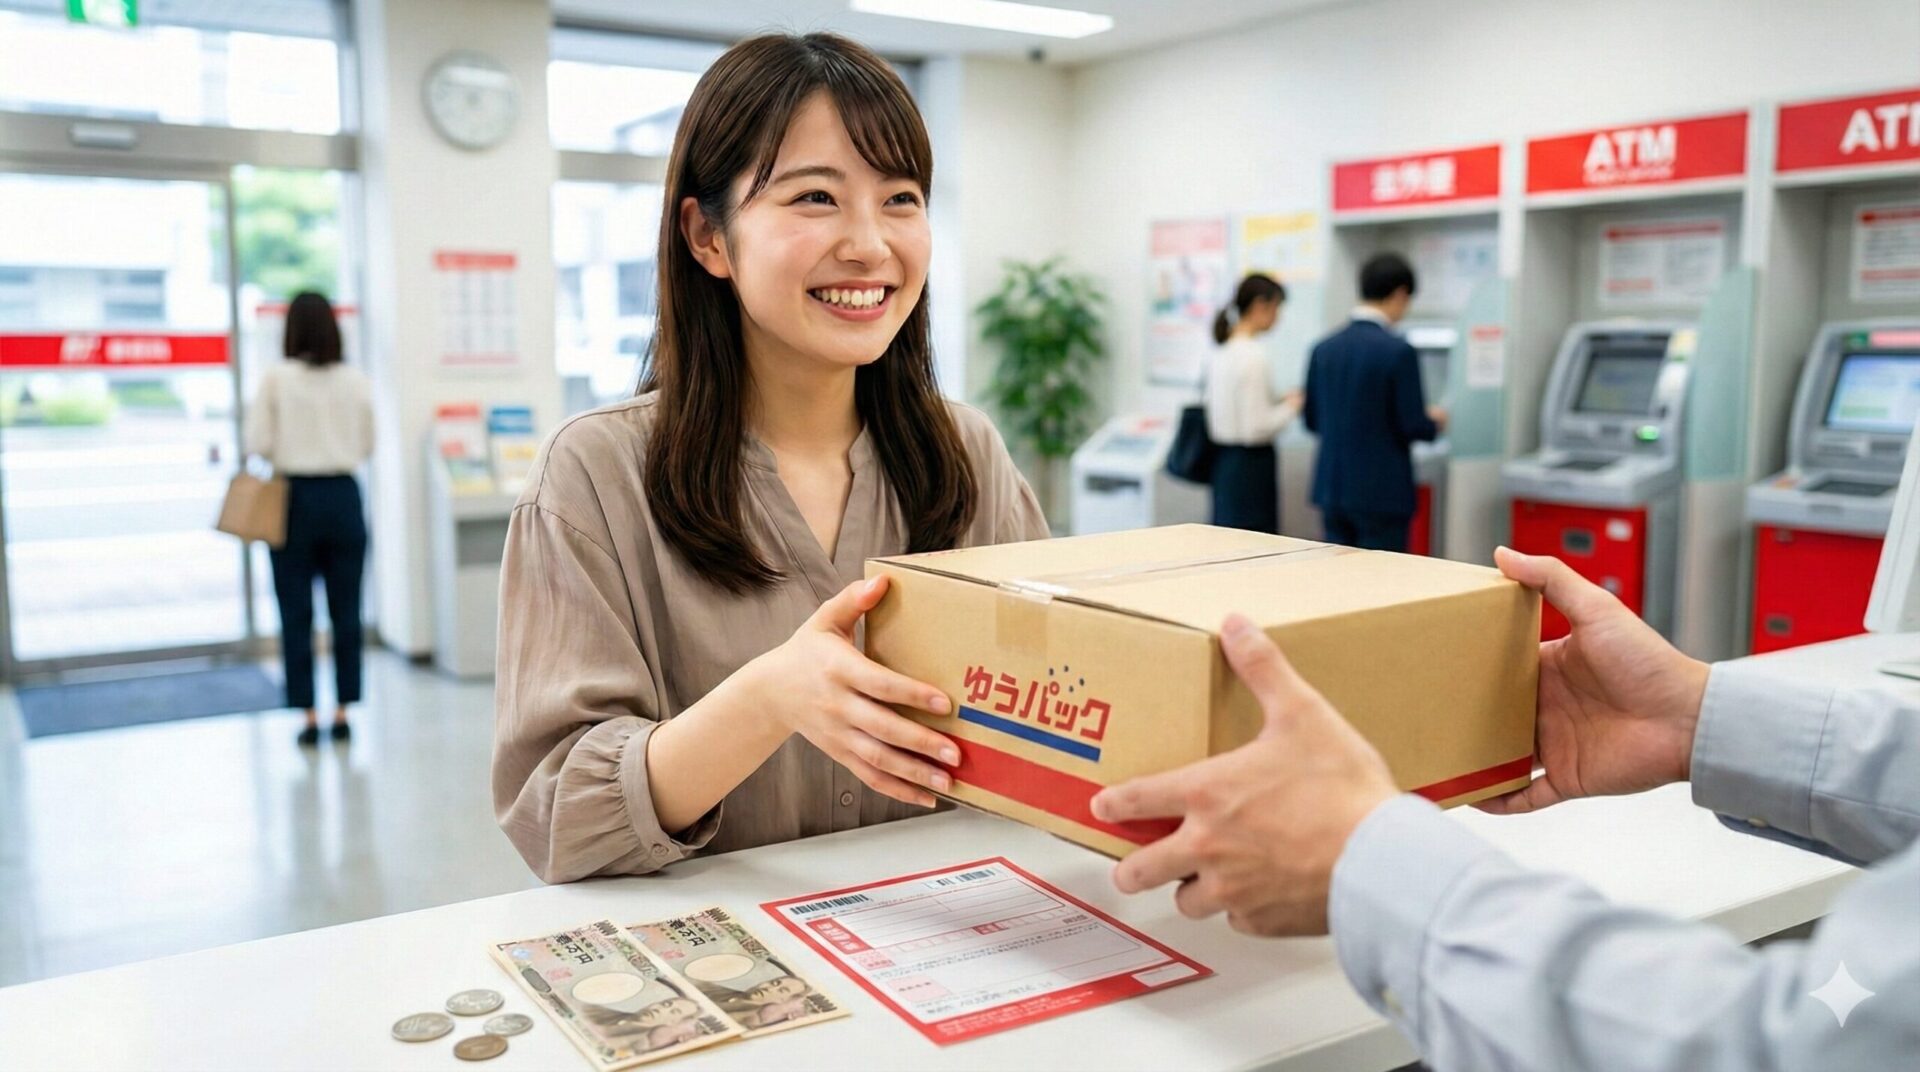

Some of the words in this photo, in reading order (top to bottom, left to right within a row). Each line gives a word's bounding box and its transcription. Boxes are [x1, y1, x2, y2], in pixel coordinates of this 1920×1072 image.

[1582, 125, 1677, 173] ATM
[963, 665, 1112, 742] ゆうパック
